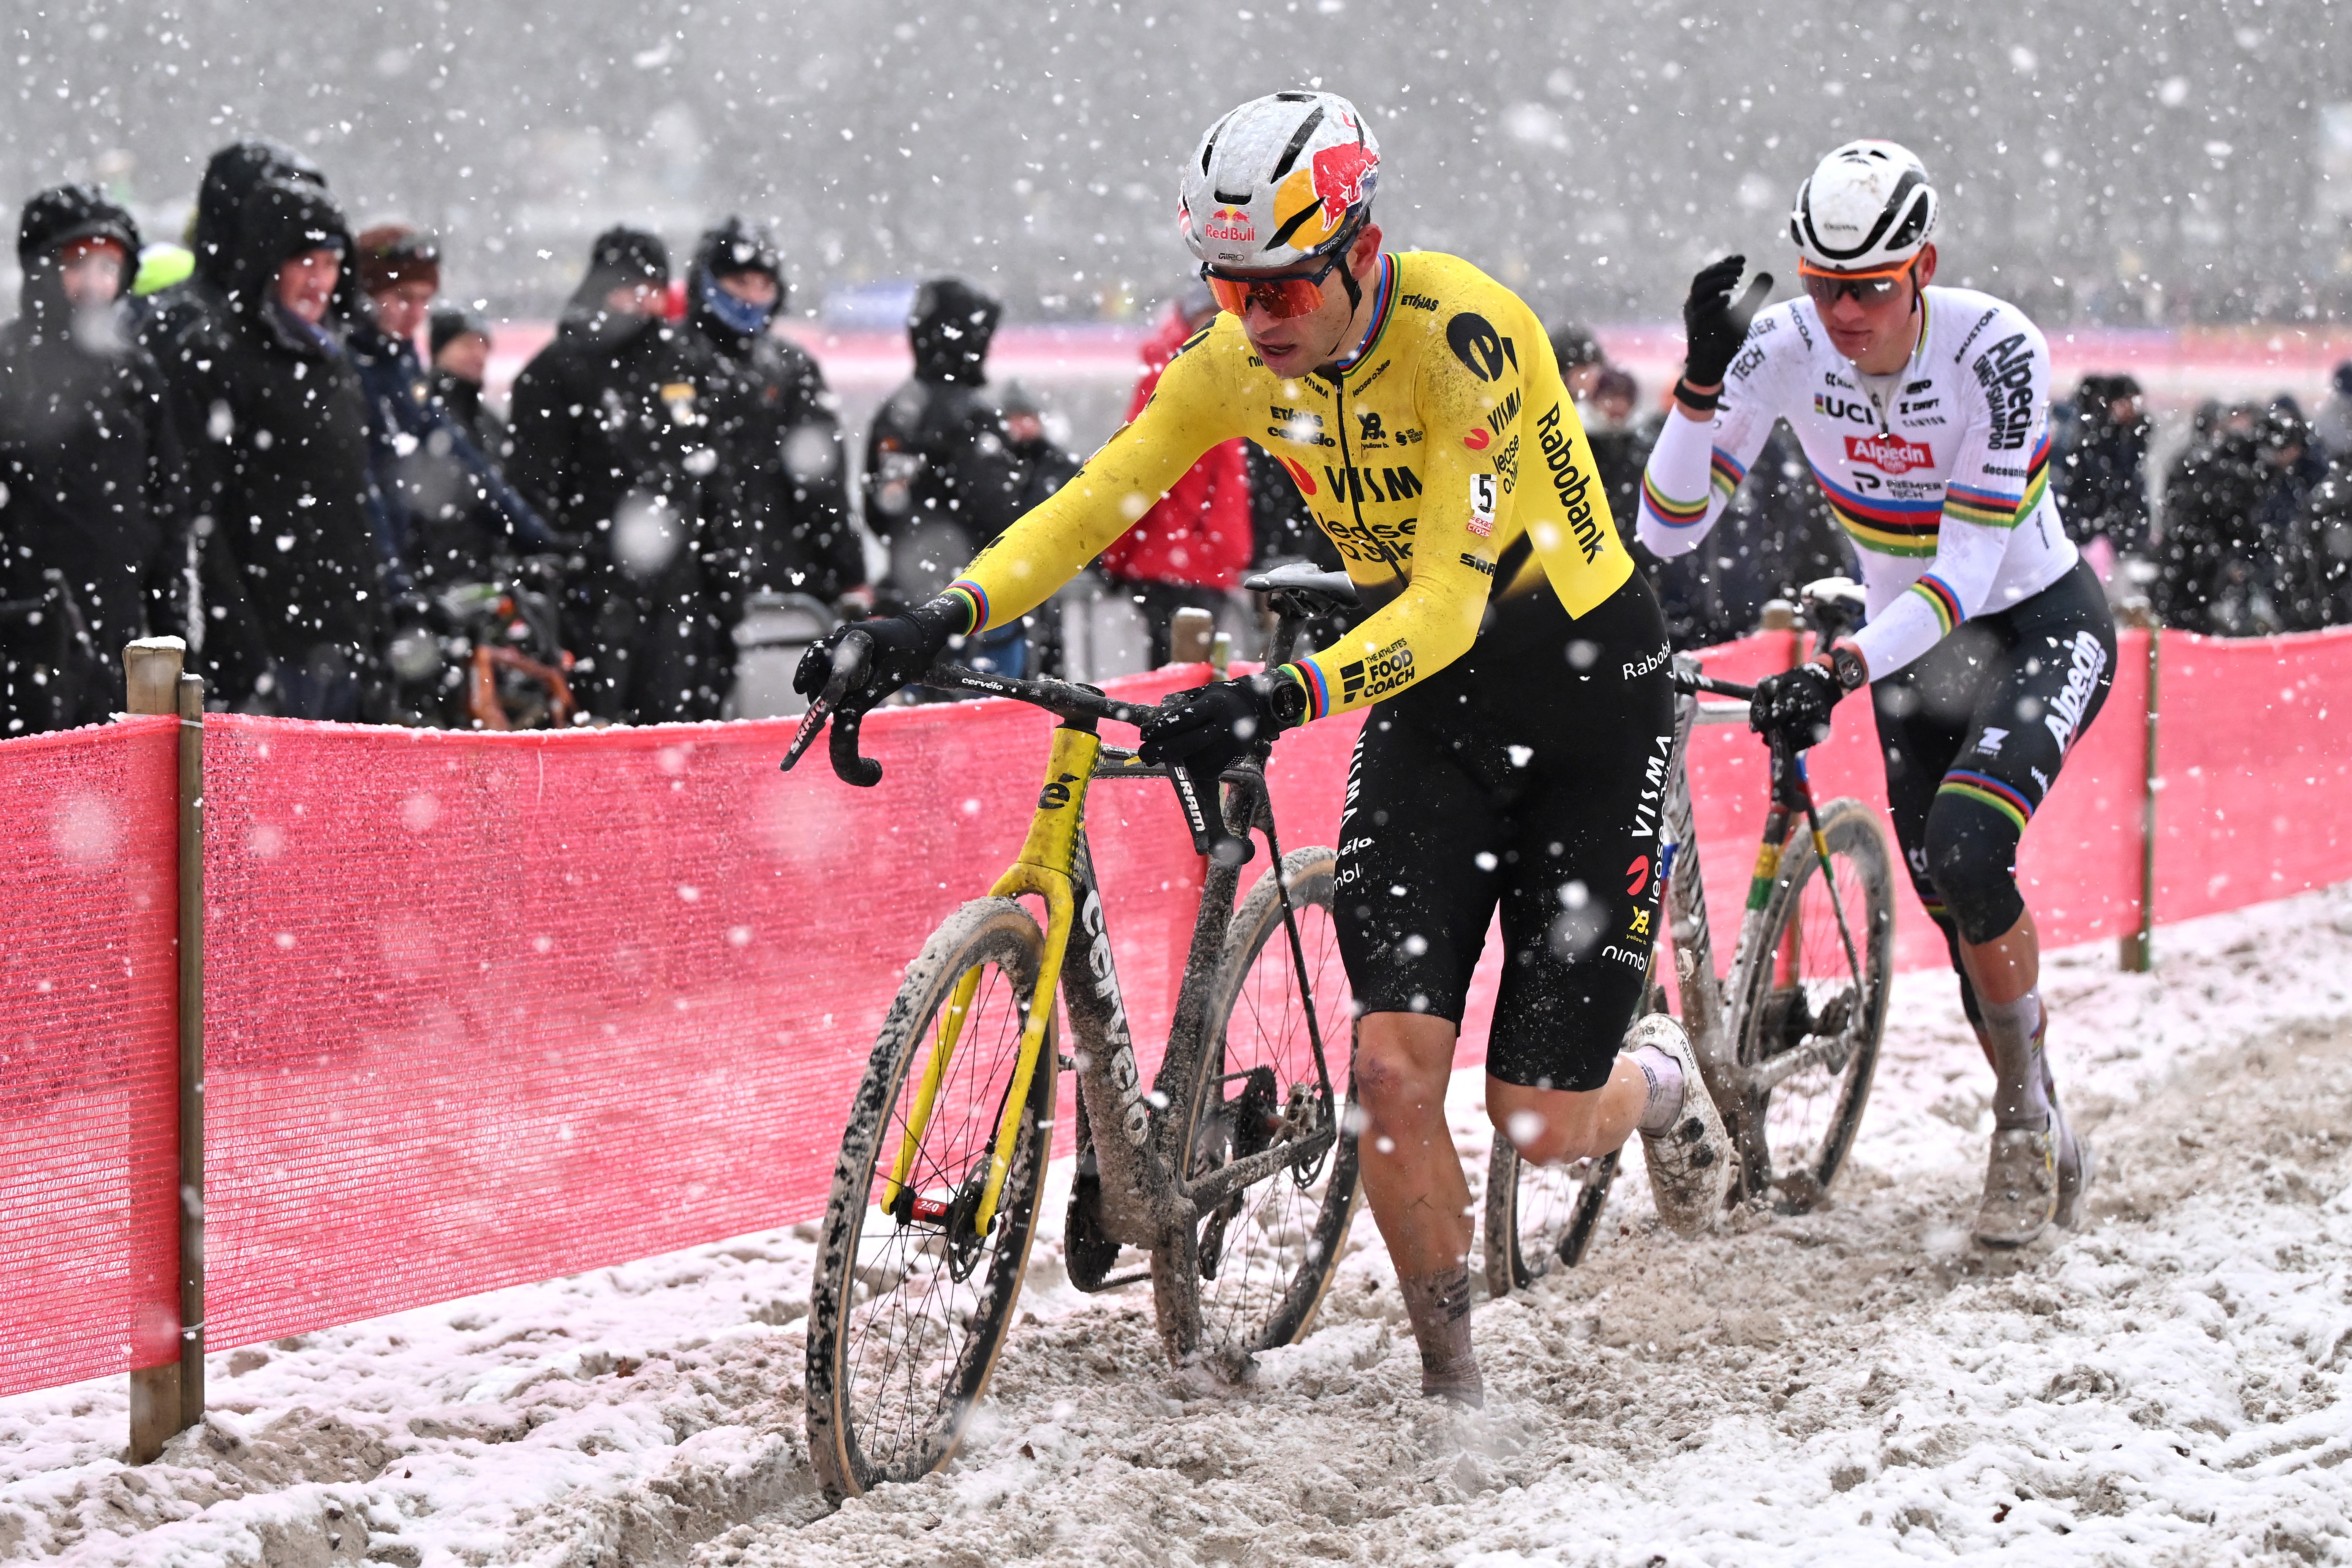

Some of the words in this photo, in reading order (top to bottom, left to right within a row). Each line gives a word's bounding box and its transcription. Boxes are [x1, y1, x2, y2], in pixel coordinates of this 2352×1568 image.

[1205, 223, 1228, 240] Red
[1230, 227, 1255, 241] Bull
[1218, 253, 1244, 261] GIRO
[1987, 333, 2034, 450] Alpecin
[1486, 387, 1522, 436] VISMA
[1825, 395, 1874, 425] UCI
[1323, 465, 1423, 503] VISM
[1478, 474, 1492, 513] 5
[1536, 400, 1605, 565] Rabobank
[1459, 552, 1496, 577] SRA
[1365, 653, 1379, 664] THE
[1377, 637, 1407, 659] ATHLETE'S
[1369, 649, 1413, 681] FOOD
[961, 678, 1004, 691] cervélo
[1364, 666, 1415, 698] COACH
[2044, 630, 2102, 755] Alpecin
[1174, 766, 1206, 832] SRAM
[1631, 735, 1672, 837] VISMA
[1626, 933, 1643, 943] yellow
[1602, 945, 1649, 972] nimbl
[1680, 1038, 1695, 1070] nimbl
